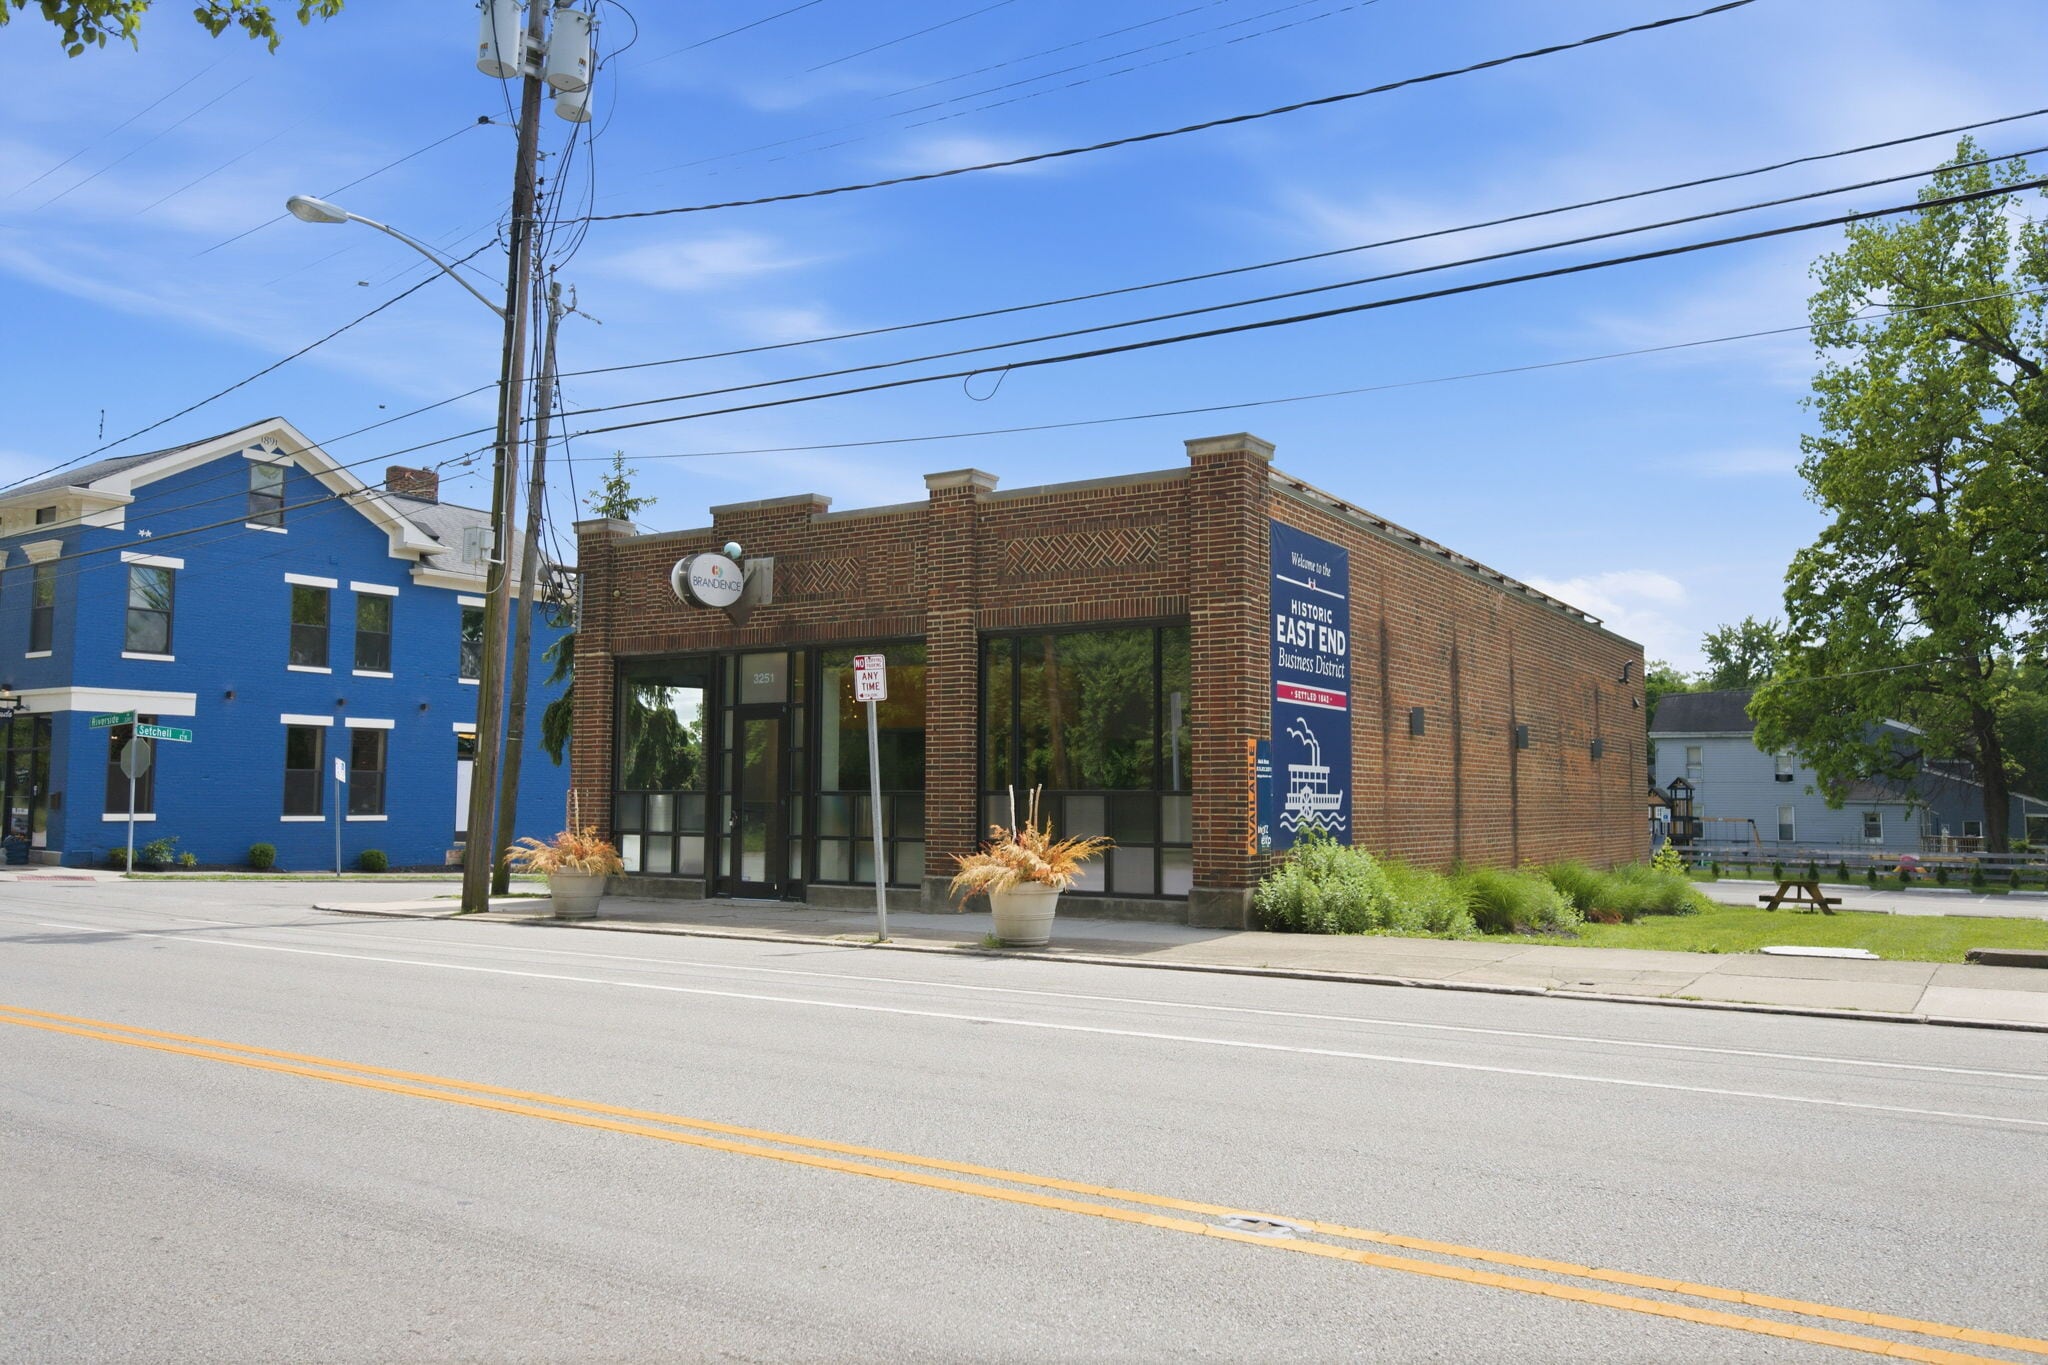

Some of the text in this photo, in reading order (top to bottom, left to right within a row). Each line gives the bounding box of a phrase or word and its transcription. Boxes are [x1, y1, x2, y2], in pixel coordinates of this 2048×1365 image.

[1291, 551, 1331, 577] Welcome to the
[693, 575, 741, 592] BRANDIENCE
[1291, 599, 1333, 624] HISTORIC
[1276, 613, 1346, 656] EAST END
[855, 659, 865, 669] NO
[1278, 646, 1345, 679] Business District
[753, 672, 775, 685] 3251
[862, 671, 879, 681] ANY
[862, 681, 881, 691] TIME
[1294, 690, 1317, 702] SETTLED
[91, 715, 120, 727] Riverside
[138, 725, 172, 738] Setchell
[1249, 745, 1257, 849] AVAILABLE
